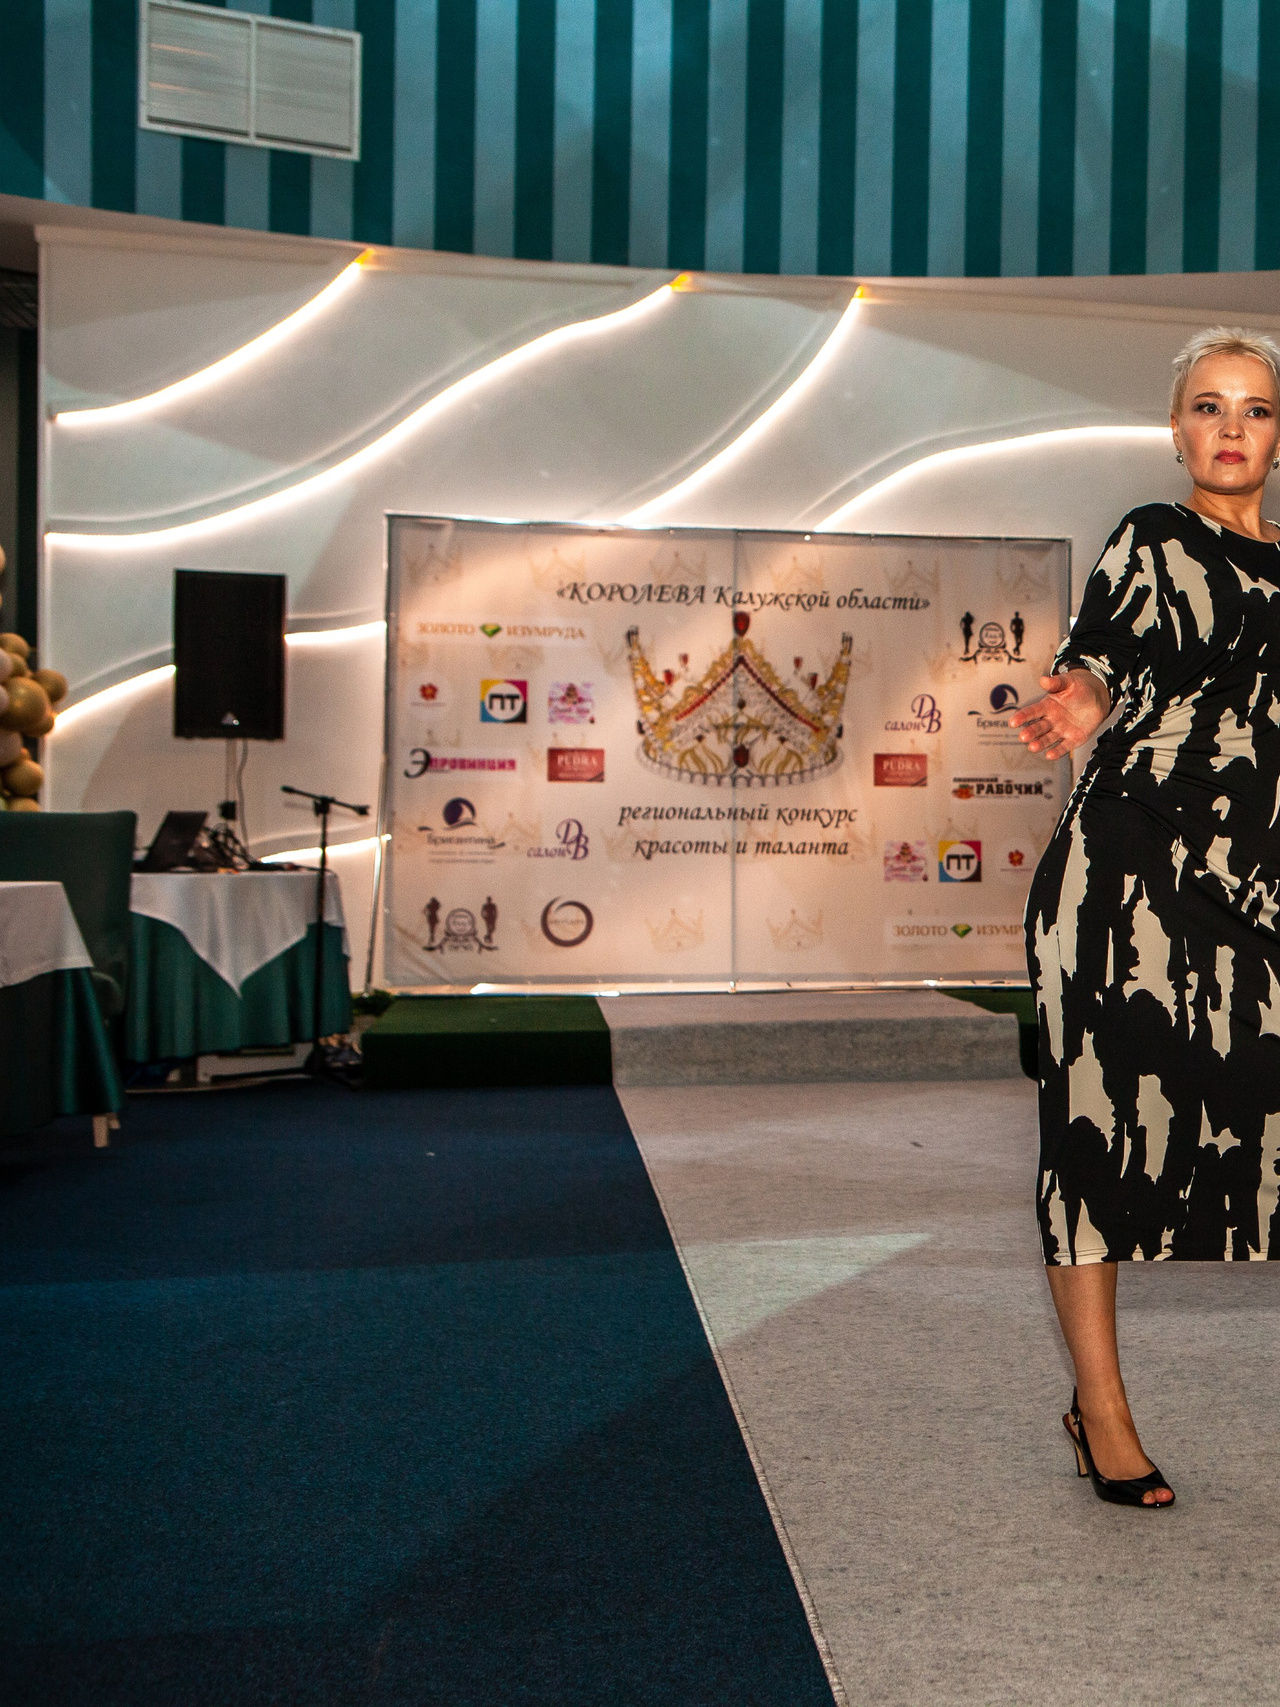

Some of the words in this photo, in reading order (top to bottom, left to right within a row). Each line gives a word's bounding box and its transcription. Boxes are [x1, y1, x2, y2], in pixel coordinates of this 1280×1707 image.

[556, 582, 706, 607] «КОРОЛЕВА
[713, 585, 830, 612] Калужской
[836, 588, 931, 611] области»
[884, 720, 921, 731] салон
[975, 780, 1044, 795] РАБОЧИЙ
[617, 803, 769, 826] региональный
[776, 806, 858, 828] конкурс
[633, 838, 728, 860] красоты
[735, 840, 747, 855] и
[754, 840, 849, 855] таланта
[894, 925, 949, 937] ЗОЛОТО
